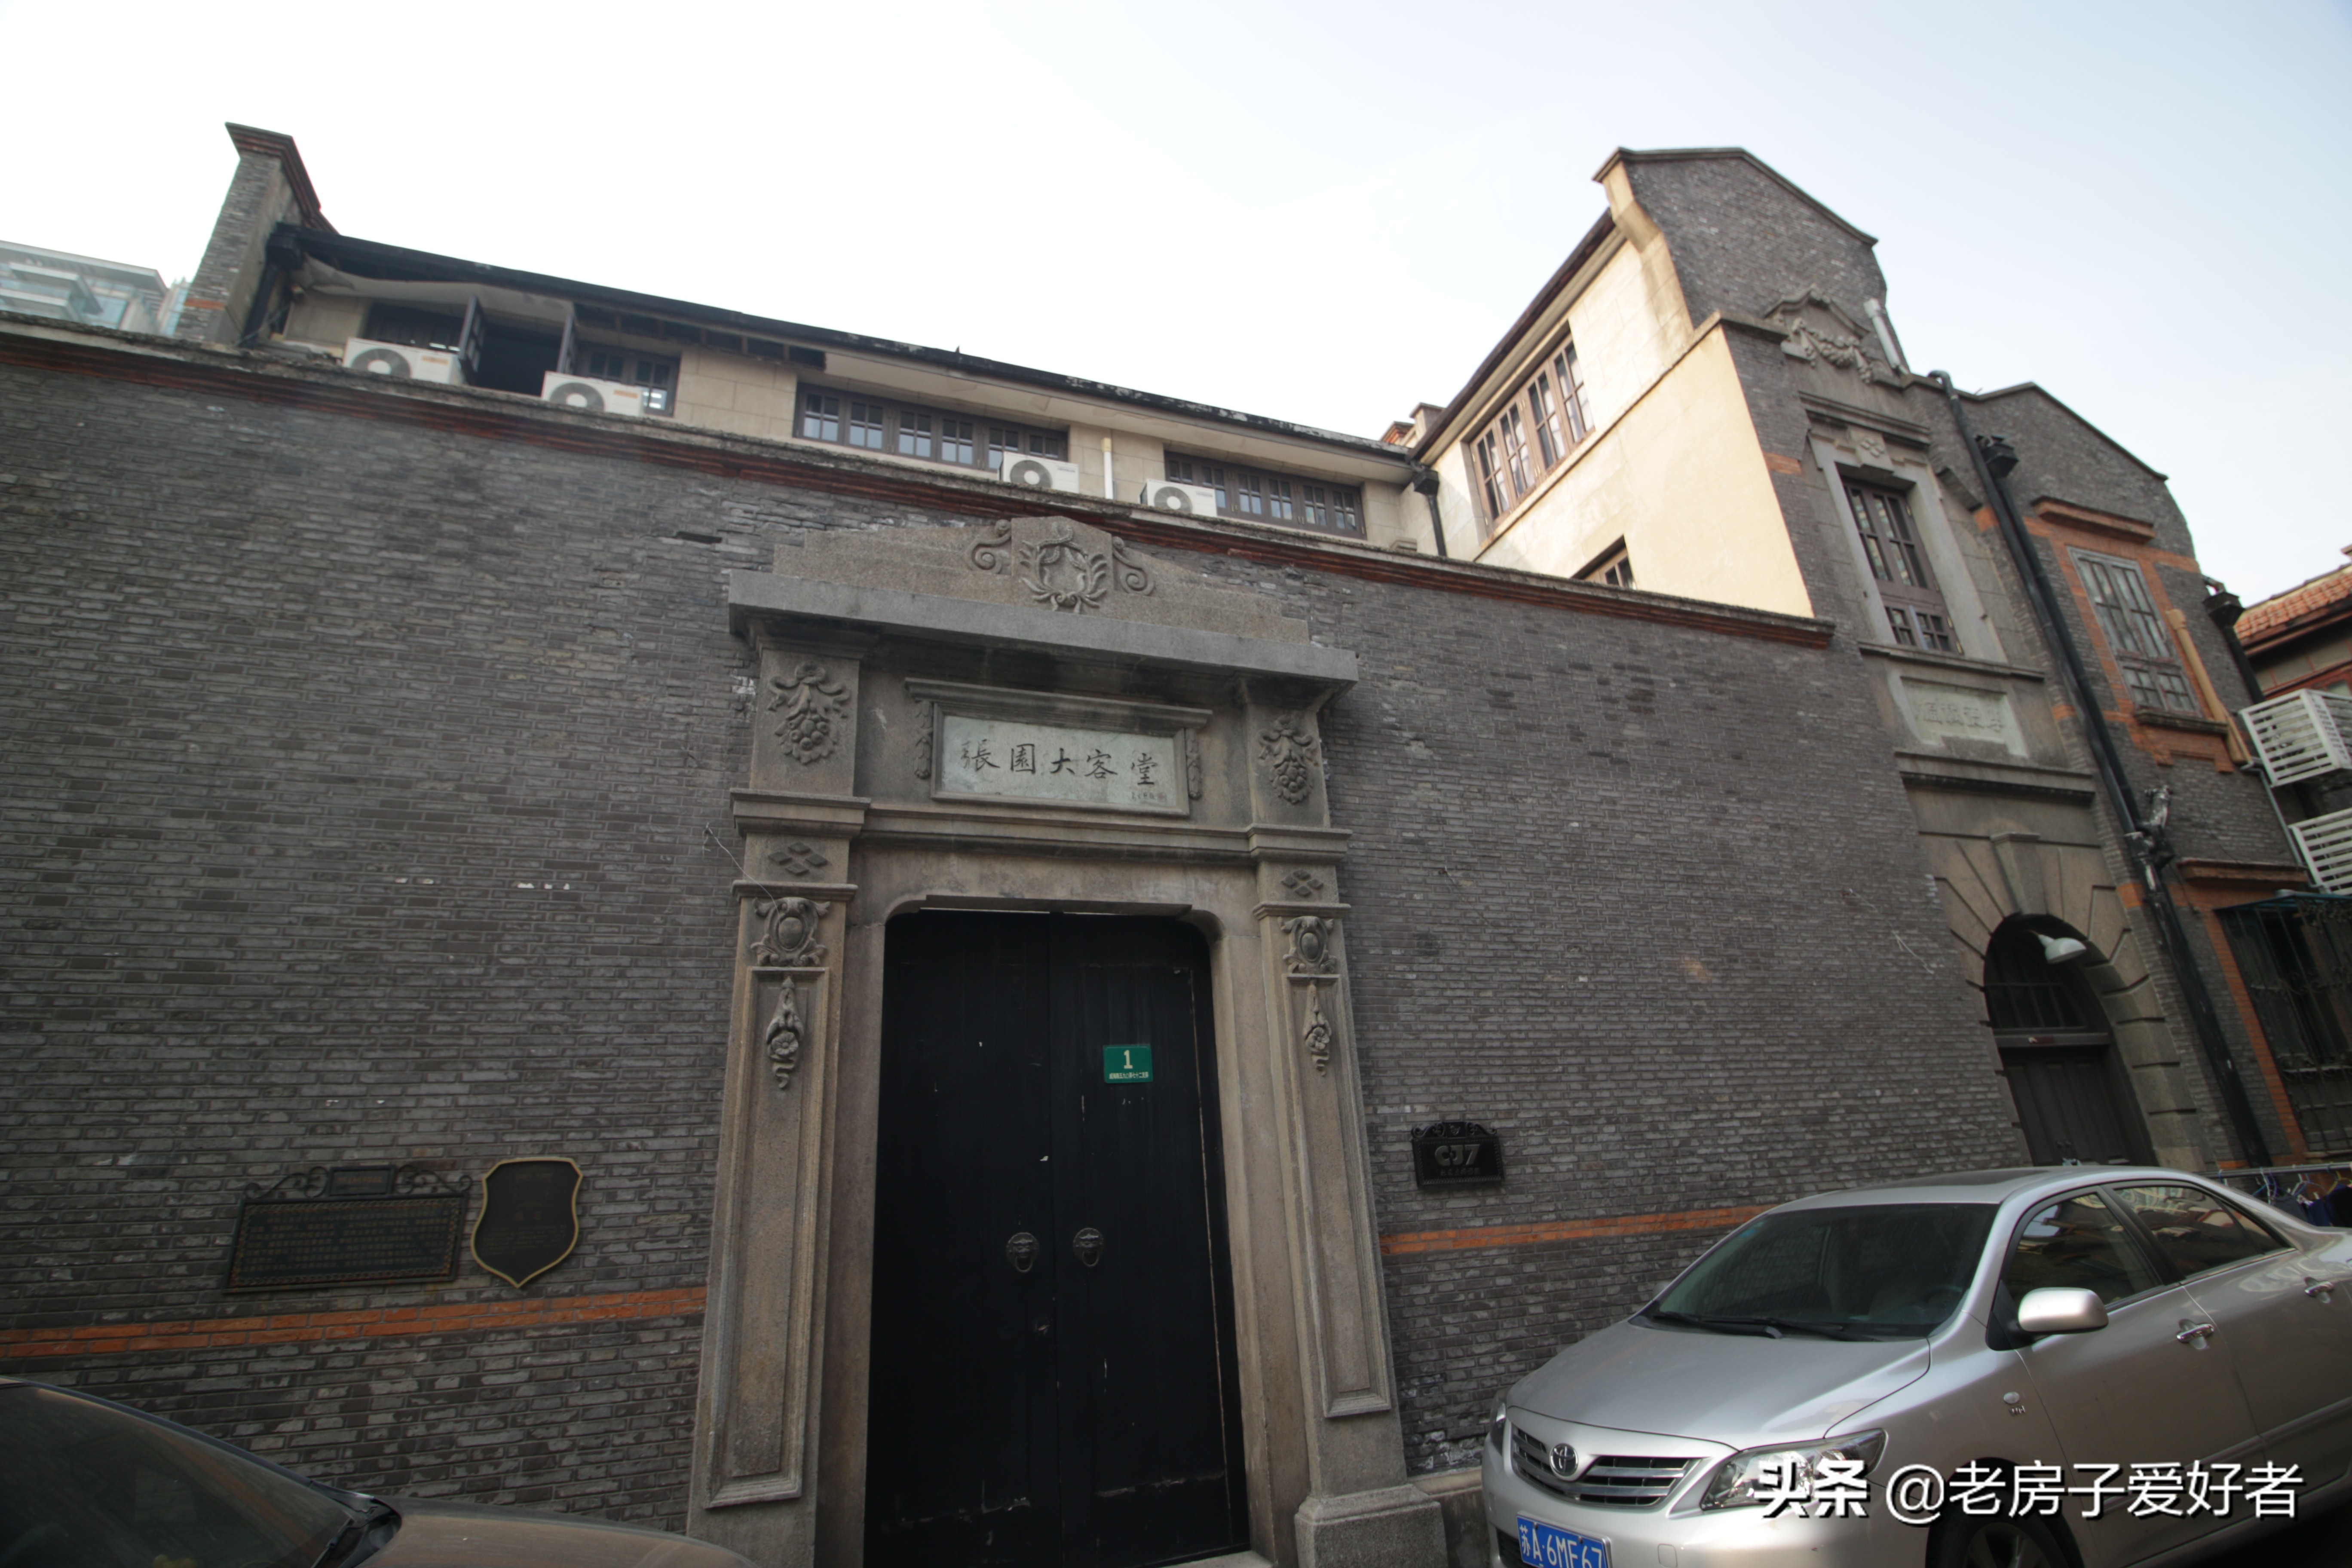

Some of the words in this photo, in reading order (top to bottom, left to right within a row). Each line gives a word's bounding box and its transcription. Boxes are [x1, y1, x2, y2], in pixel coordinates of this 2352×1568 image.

[961, 738, 1158, 785] 張園大客堂
[1124, 1050, 1133, 1069] 1
[1434, 1144, 1480, 1166] CJ7
